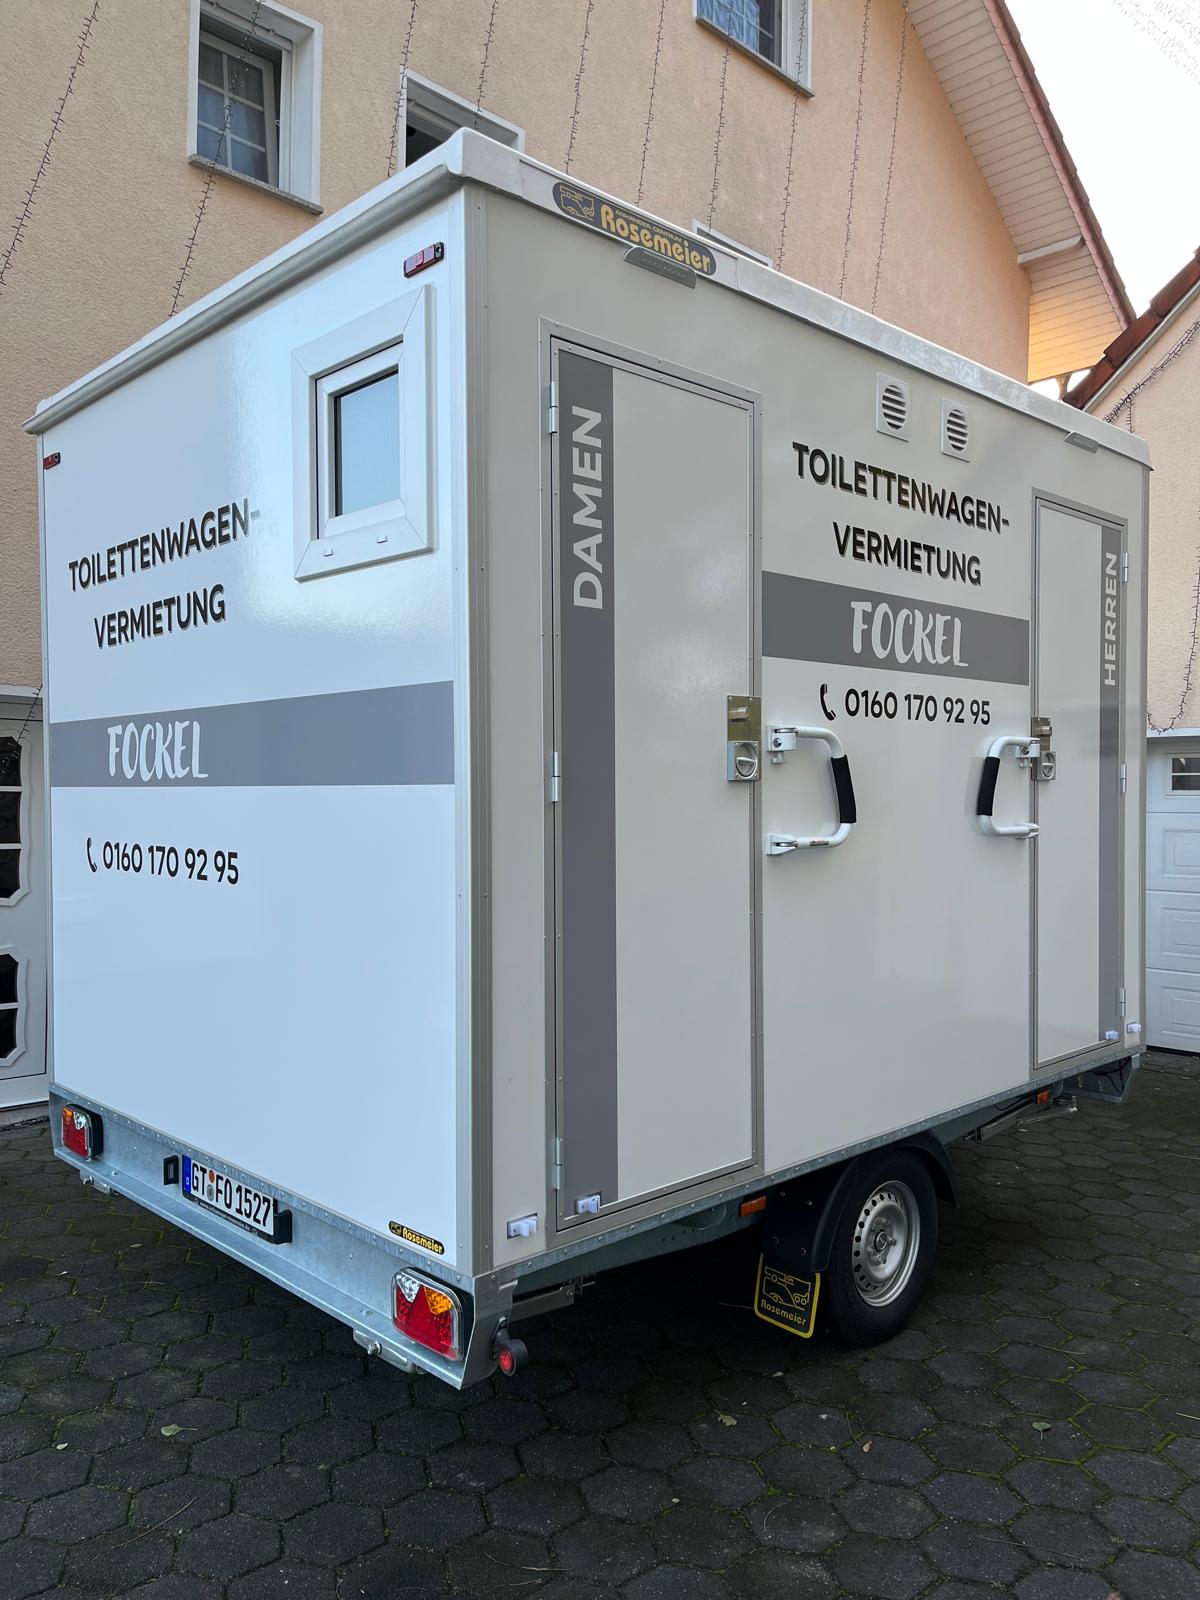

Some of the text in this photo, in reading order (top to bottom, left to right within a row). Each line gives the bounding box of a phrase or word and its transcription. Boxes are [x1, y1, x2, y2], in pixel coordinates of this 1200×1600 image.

[600, 204, 711, 273] Rosemeier
[572, 405, 603, 609] DAMEN
[792, 441, 1010, 535] TOILETTENWAGEN-
[68, 498, 261, 592] TOILETTENWAGEN-
[833, 521, 982, 587] VERMIETUNG
[94, 584, 226, 649] VERMIETUNG
[850, 601, 969, 667] FOCKEL
[1104, 552, 1117, 686] HERREN
[845, 688, 991, 726] 0160 170 92 95
[107, 720, 209, 782] FOCKEL
[103, 841, 239, 885] 0160 170 92 95
[192, 1162, 207, 1196] GT
[235, 1184, 271, 1227] 1527
[402, 1227, 443, 1254] Rosemeier
[760, 1299, 807, 1326] Rosemeier
